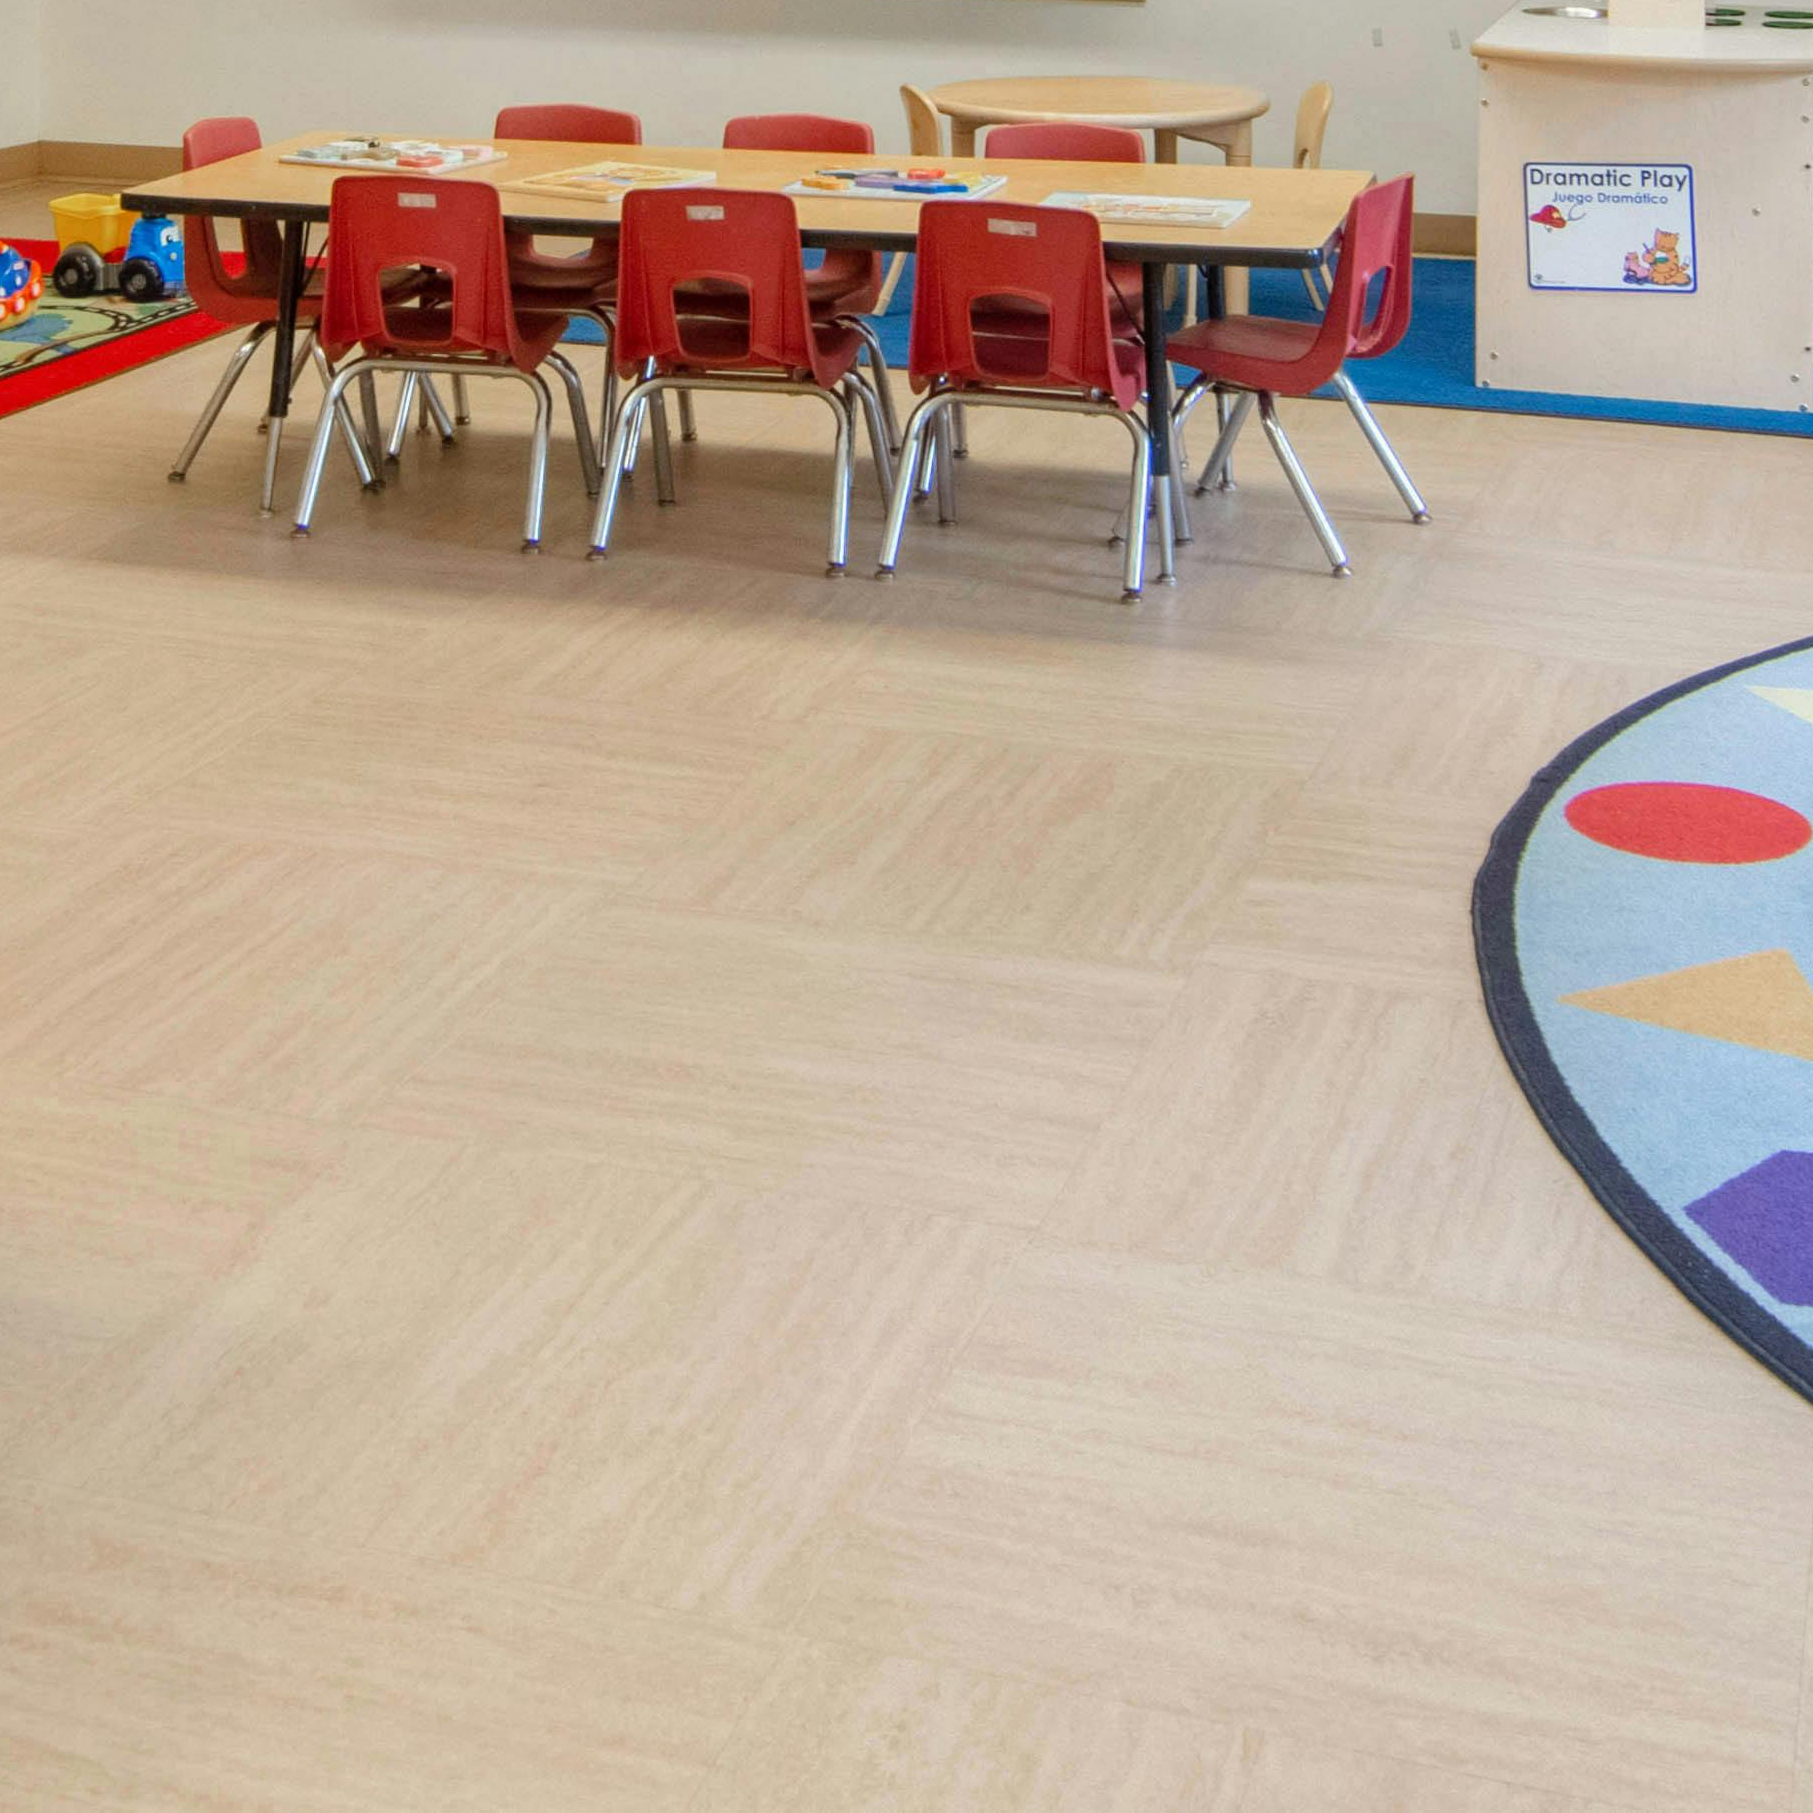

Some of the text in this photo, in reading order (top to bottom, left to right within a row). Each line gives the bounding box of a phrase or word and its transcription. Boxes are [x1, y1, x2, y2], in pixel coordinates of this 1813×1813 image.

[1530, 168, 1687, 192] Dramatic Play
[1552, 192, 1668, 205] Juego Dramático
